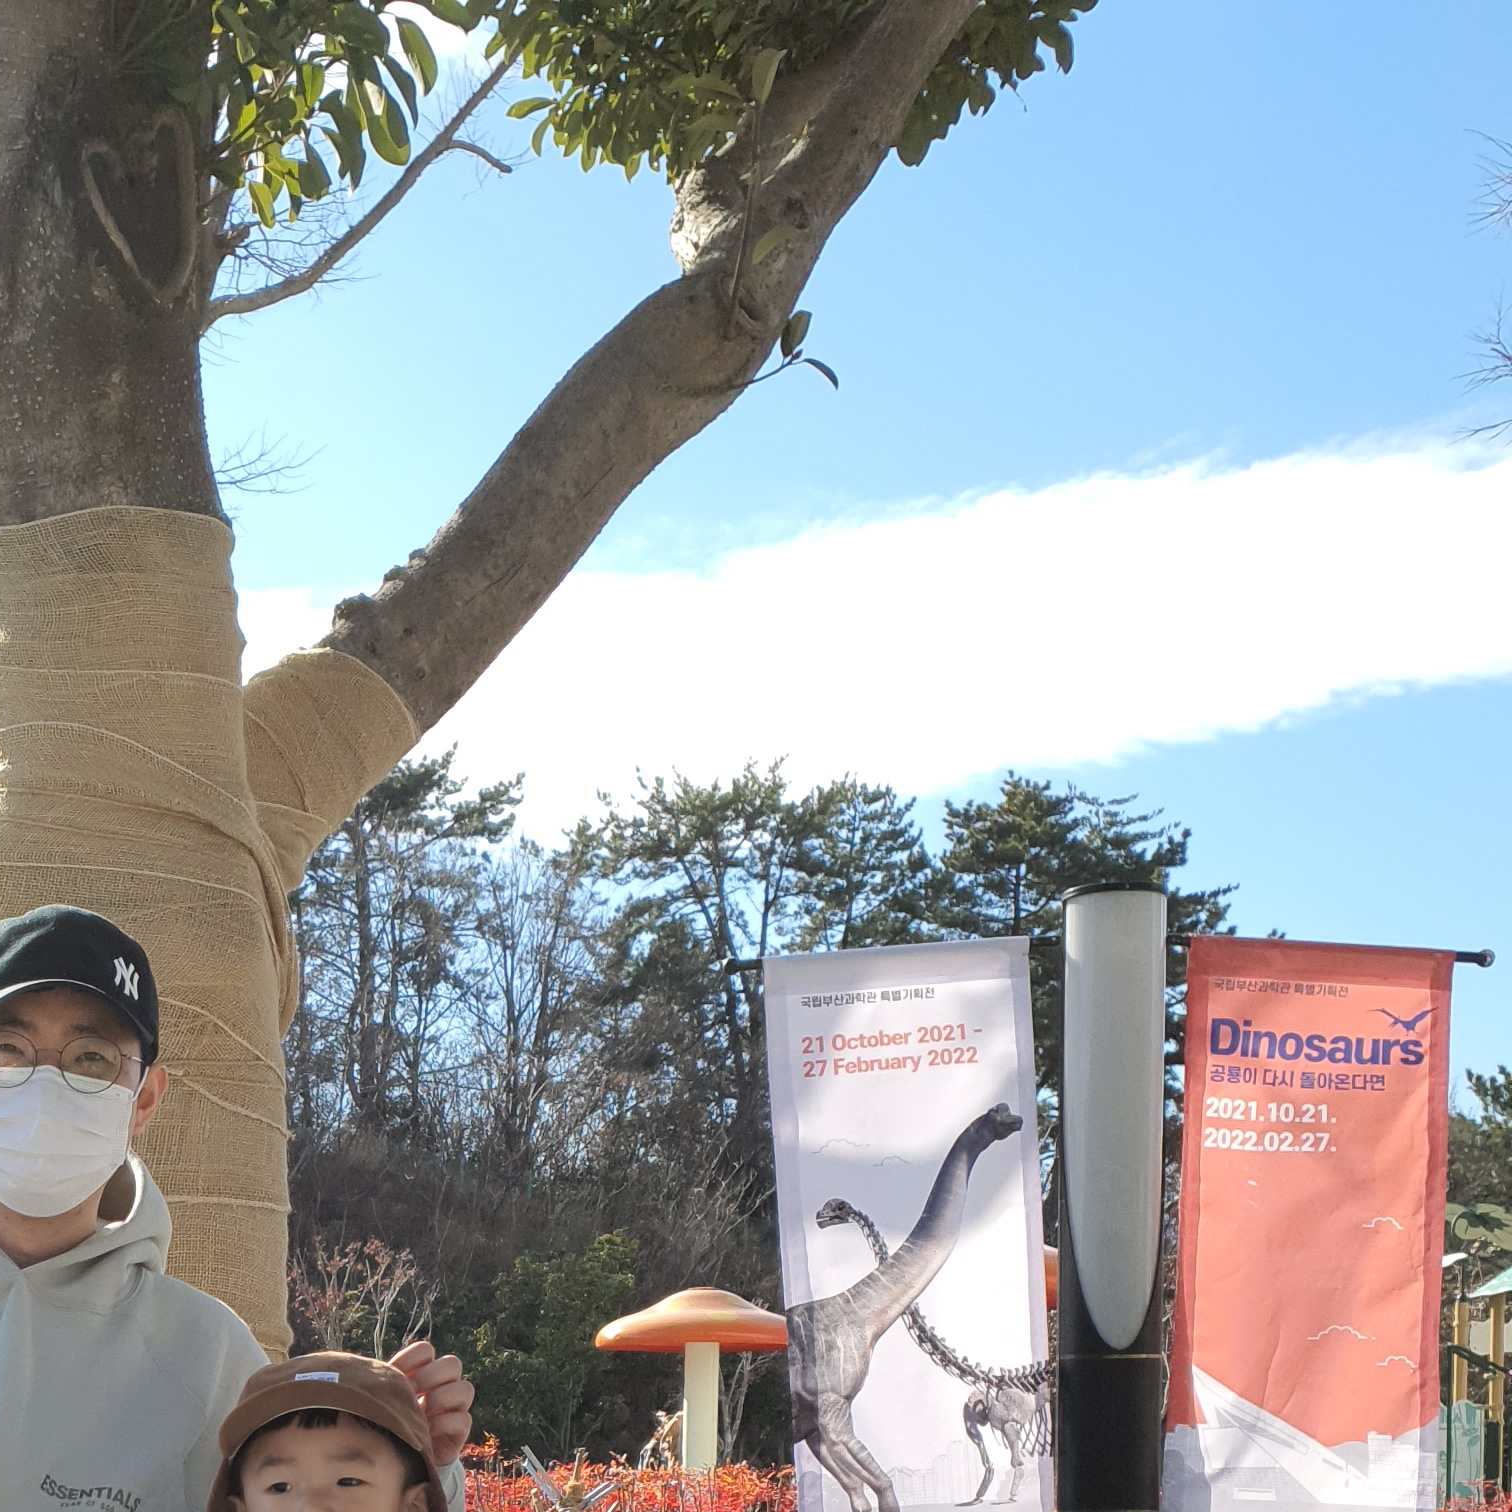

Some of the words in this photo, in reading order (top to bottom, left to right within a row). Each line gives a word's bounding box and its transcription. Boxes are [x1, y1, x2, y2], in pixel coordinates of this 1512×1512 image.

[800, 991, 877, 1008] 국립부산과학관
[880, 987, 935, 1003] 특별기획전
[801, 1036, 825, 1055] 21
[832, 1030, 912, 1053] October
[917, 1023, 967, 1044] 2021
[1209, 1017, 1425, 1066] Dinosaurs
[803, 1060, 827, 1078] 27
[834, 1051, 922, 1075] February
[928, 1046, 979, 1066] 2022
[1209, 1065, 1257, 1085] 공룡이
[1262, 1068, 1295, 1088] 다시
[1299, 1071, 1386, 1091] 돌아온다면
[1205, 1096, 1337, 1124] 2021.10.21.
[1203, 1126, 1337, 1153] 2022.02.27.
